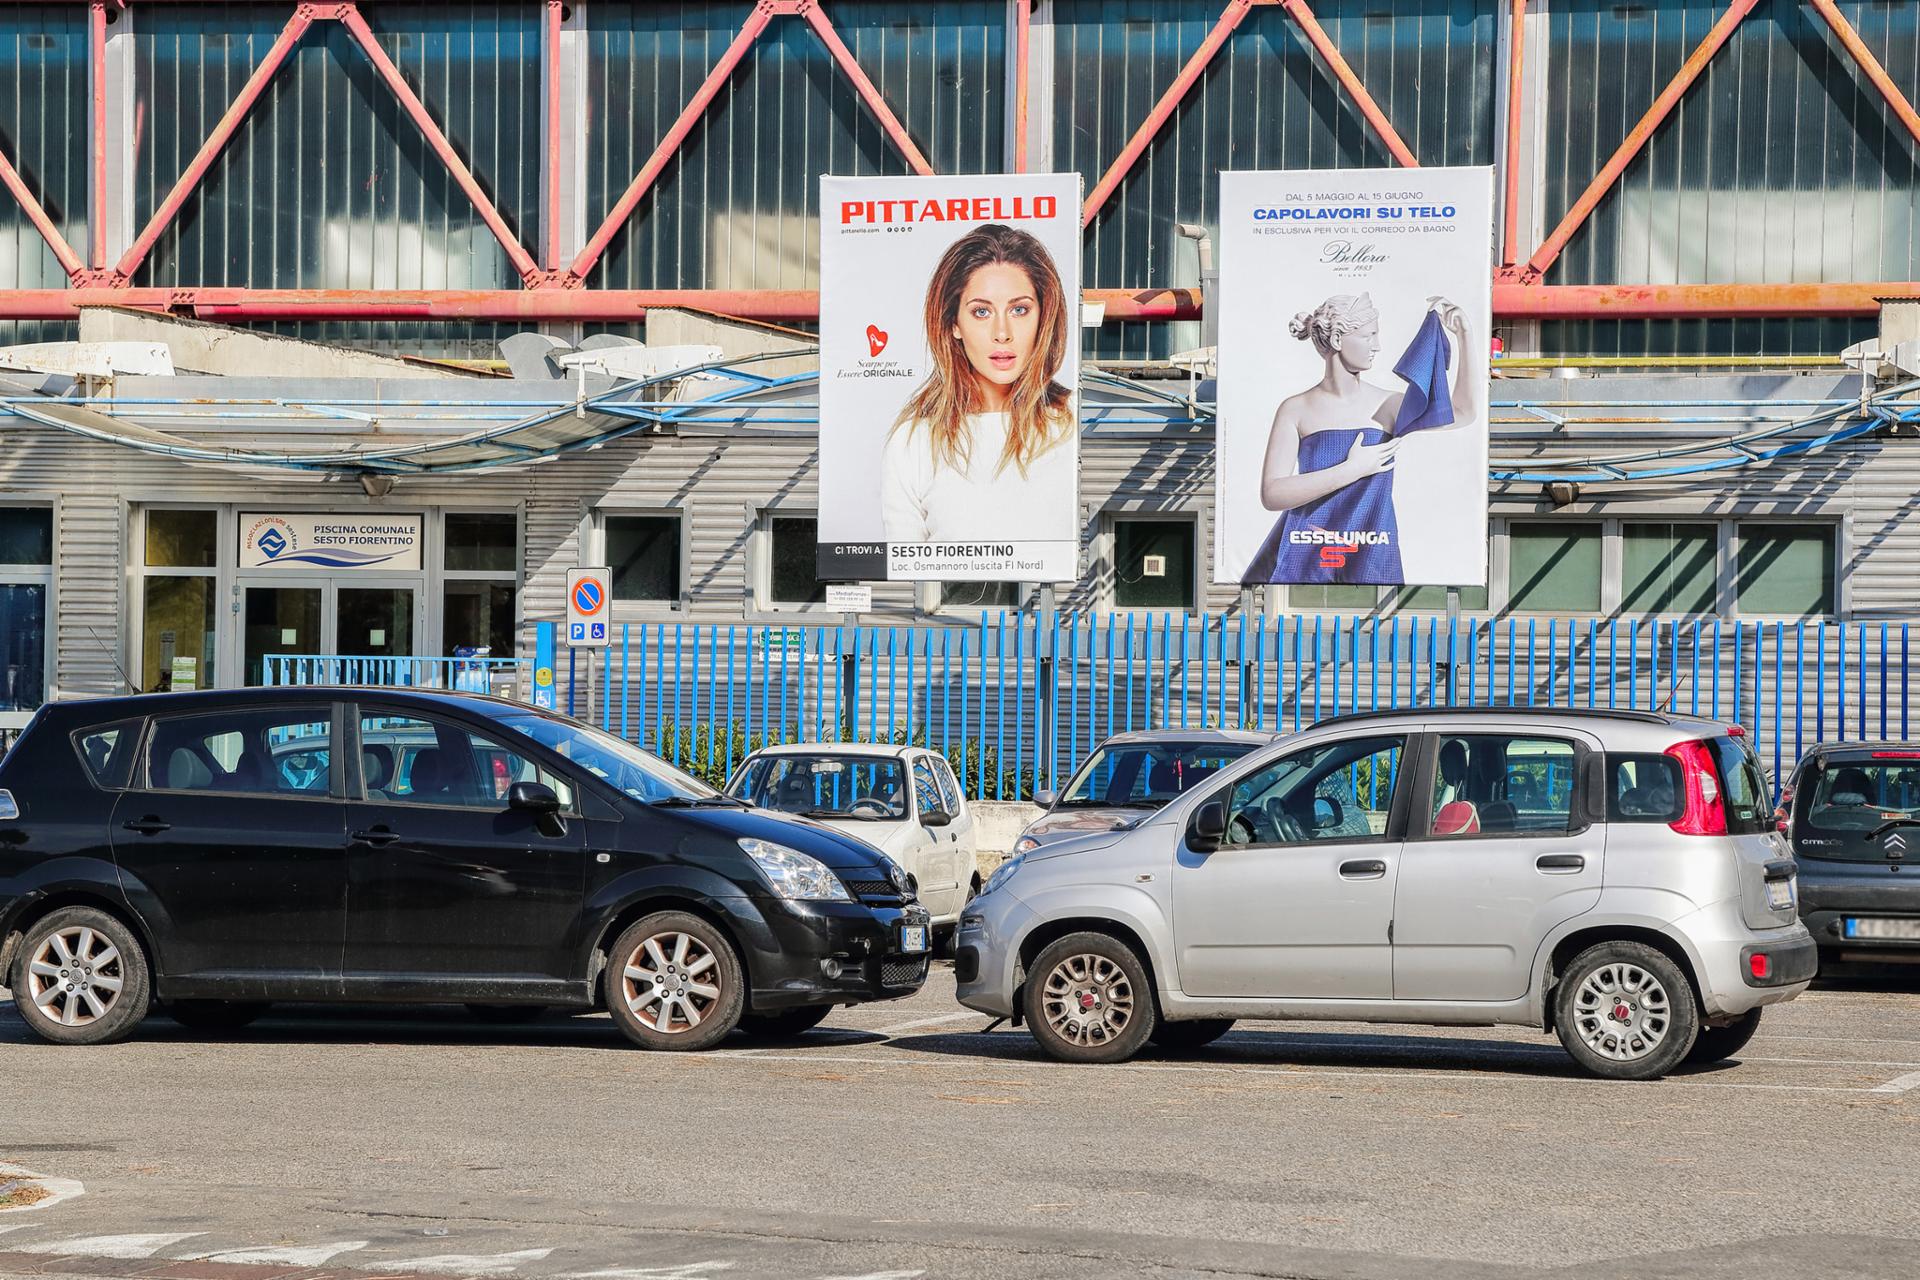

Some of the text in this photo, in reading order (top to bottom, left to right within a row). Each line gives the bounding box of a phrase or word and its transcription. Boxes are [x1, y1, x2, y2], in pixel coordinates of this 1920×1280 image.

[1285, 193, 1304, 201] DAL
[1307, 193, 1313, 201] 5
[1315, 193, 1355, 201] MAGGIO
[1373, 192, 1382, 200] 15
[1385, 192, 1424, 200] GIUGNO
[841, 196, 1056, 224] PITTARELLO
[1253, 206, 1456, 220] CAPOLAVORI SU TELO
[1252, 227, 1262, 235] IN
[1264, 227, 1312, 235] ESCLUSIVA
[1351, 226, 1359, 234] IL
[1361, 226, 1406, 234] CORREDO
[1408, 225, 1421, 233] DA
[1423, 225, 1456, 233] BAGNO
[1319, 240, 1387, 263] Bellora
[857, 359, 898, 370] Scarpe per
[837, 369, 863, 378] Essere
[314, 525, 415, 535] PISCINA COMUNALE
[313, 536, 413, 545] SESTO FIORENTINO
[1289, 530, 1390, 545] ESSELUNGA
[835, 546, 844, 555] CI
[846, 545, 873, 555] TROVI
[892, 545, 1014, 557] SESTO FIORENTINO
[892, 560, 1044, 571] Loc. Osmannoro (uscita FI Nord)
[573, 625, 582, 638] P
